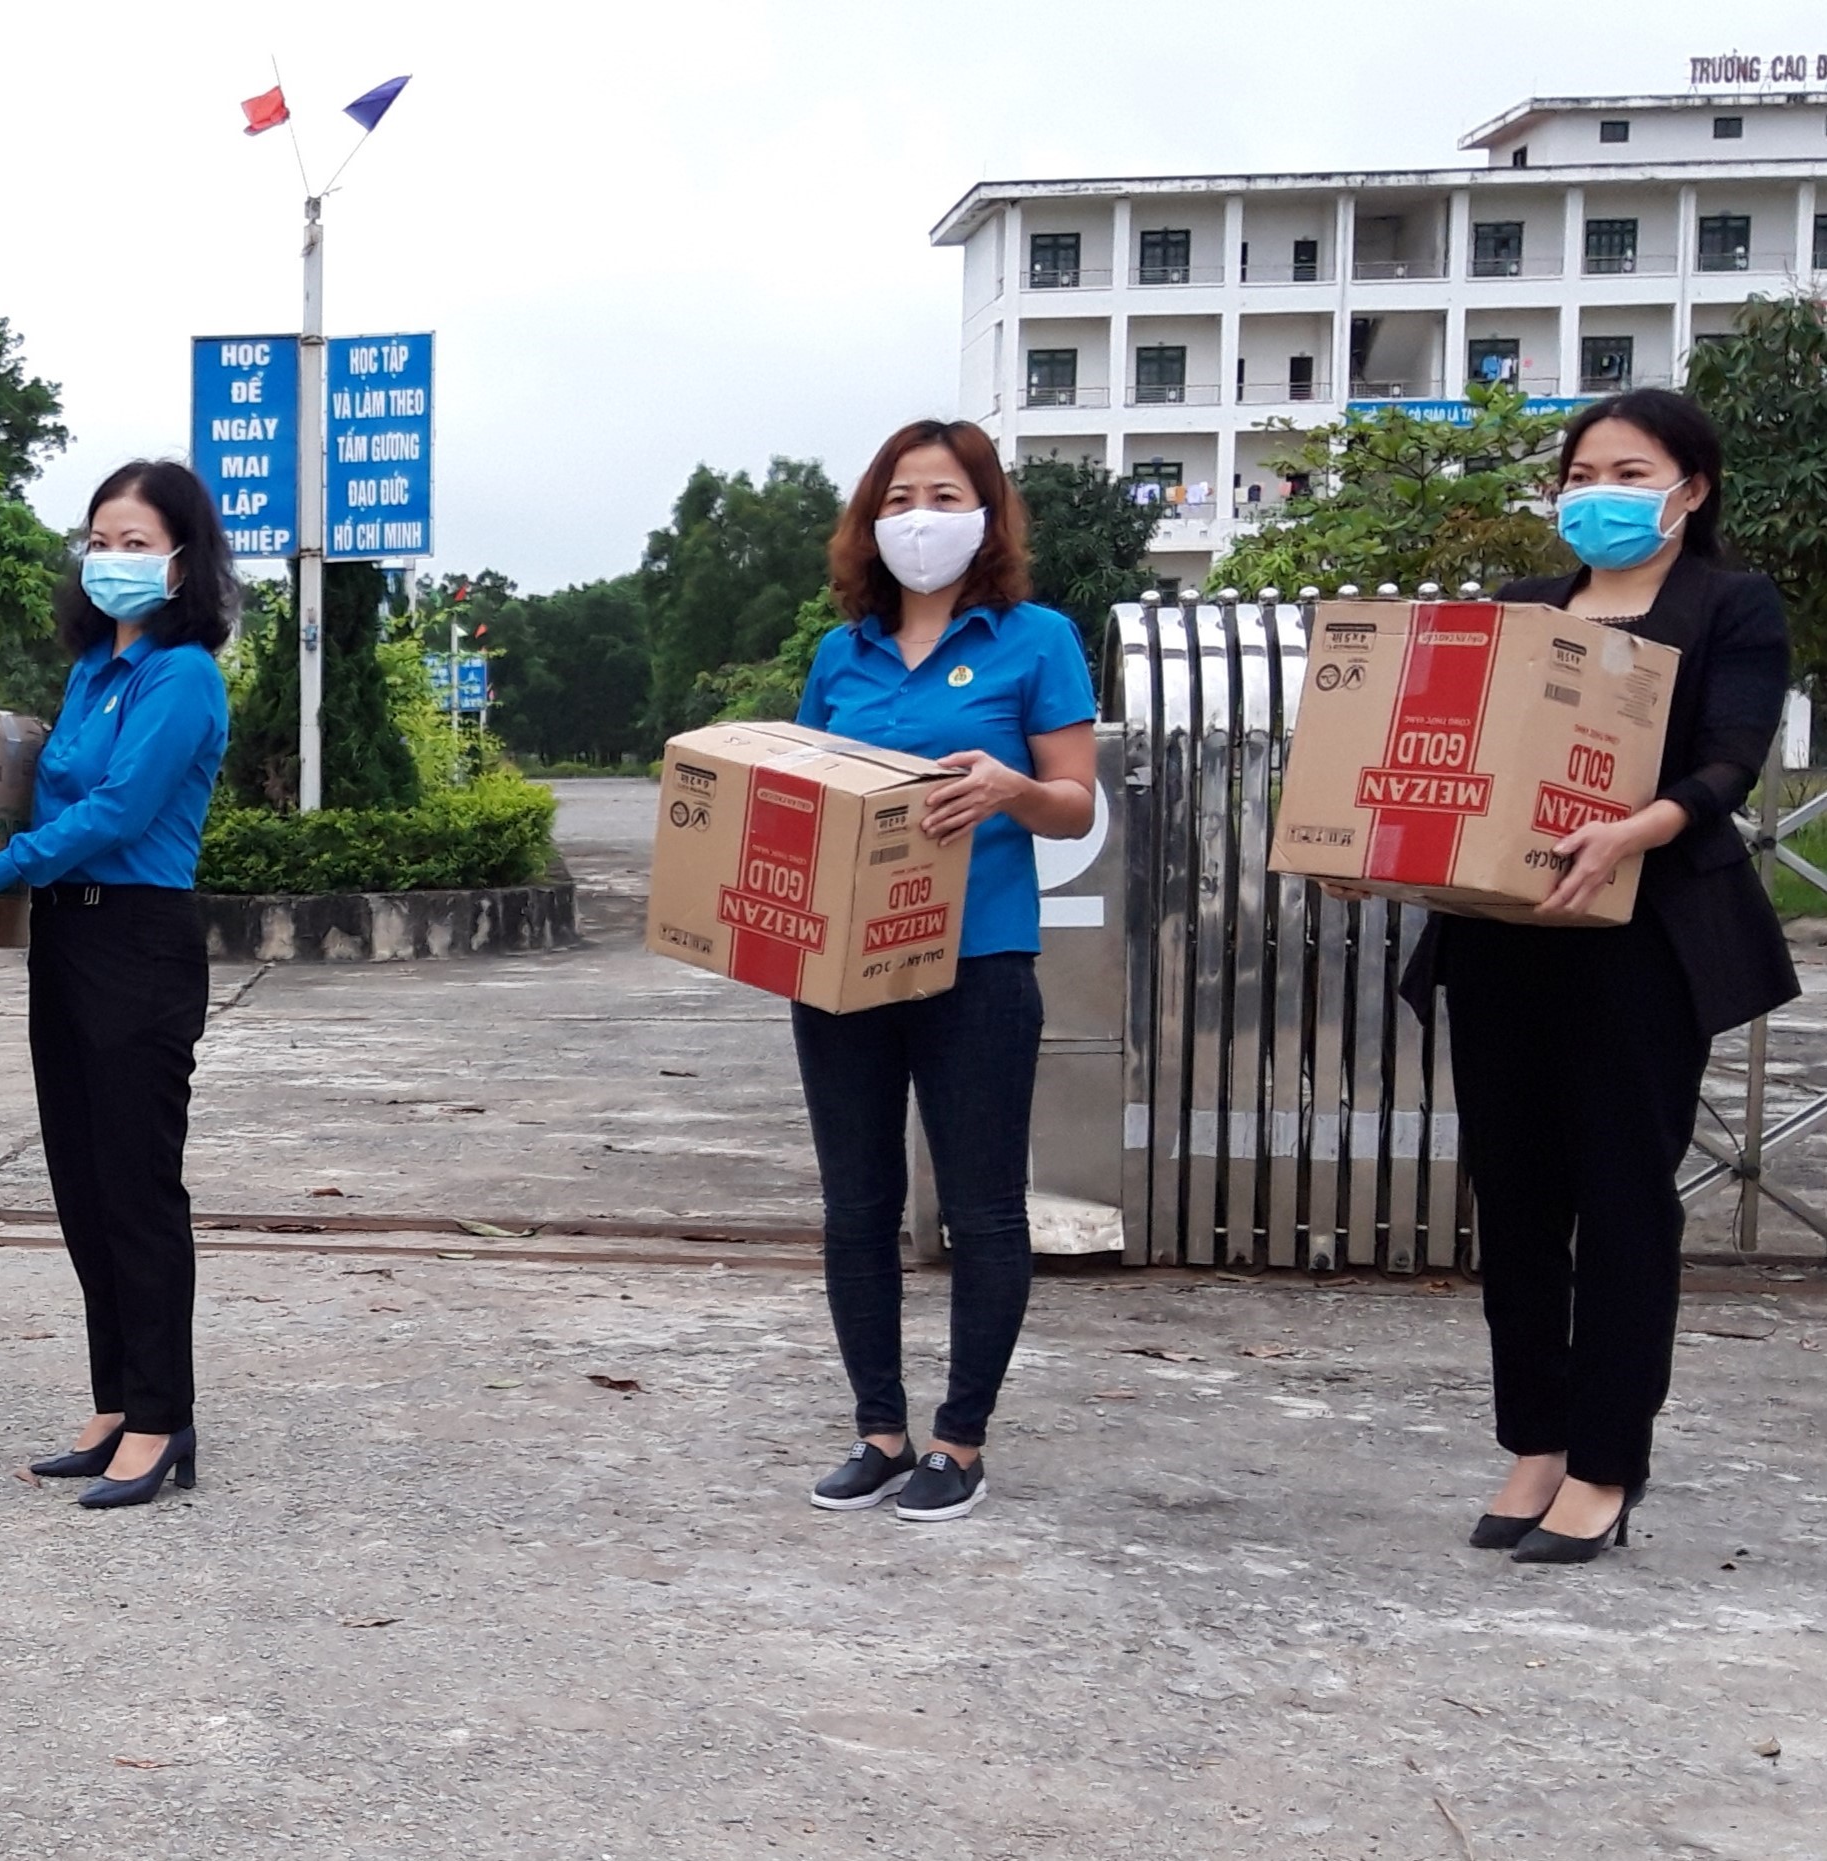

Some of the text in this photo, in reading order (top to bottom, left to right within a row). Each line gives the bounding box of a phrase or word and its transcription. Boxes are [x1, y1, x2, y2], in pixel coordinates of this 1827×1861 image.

[1689, 48, 1761, 84] TRƯỜNG
[1771, 54, 1807, 82] CAO
[220, 343, 270, 371] HỌC
[349, 340, 409, 380] HỌC TẬP
[230, 371, 264, 404] ĐỂ
[333, 386, 424, 420] VÀ LÀM THEO
[212, 412, 279, 442] NGÀY
[336, 426, 420, 463] TẤM GƯƠNG
[221, 456, 269, 478] MAI
[222, 489, 269, 520] LẬP
[347, 471, 409, 512] ĐẠO ĐỨC
[222, 525, 290, 556] GHIỆP
[333, 515, 422, 551] HỒ CHÍ MINH
[1396, 731, 1466, 767] GOLD
[1567, 744, 1616, 793] GOLD
[1362, 775, 1486, 806] MEIZAN
[747, 859, 805, 903] GOLD
[888, 876, 933, 910] GOLD
[722, 894, 823, 944] MEIZAN
[866, 910, 945, 949] MEIZAN
